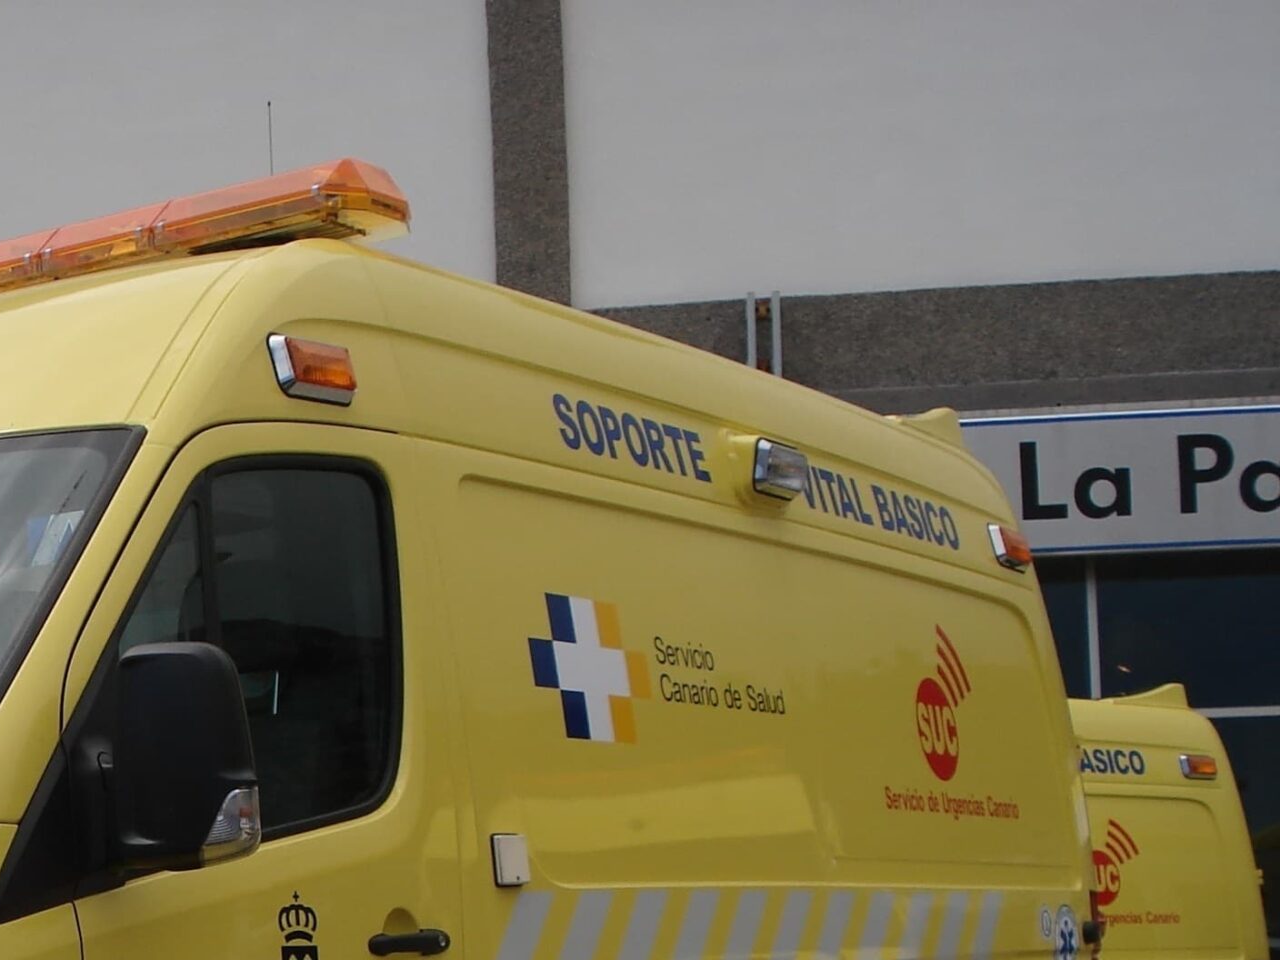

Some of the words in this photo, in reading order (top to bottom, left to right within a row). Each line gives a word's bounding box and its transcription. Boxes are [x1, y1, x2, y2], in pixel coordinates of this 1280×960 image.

[553, 393, 713, 484] SOPORTE
[870, 484, 960, 551] BASICO
[1019, 441, 1133, 520] La
[653, 635, 715, 671] Servicio
[660, 673, 719, 707] Canario
[723, 682, 743, 710] de
[745, 684, 786, 714] Salud
[916, 701, 959, 757] SUC
[1080, 748, 1145, 775] ASICO
[884, 785, 925, 812] Servicio
[927, 789, 940, 813] de
[941, 791, 986, 821] Urgencias
[986, 795, 1020, 819] Canario
[1096, 864, 1121, 893] UC
